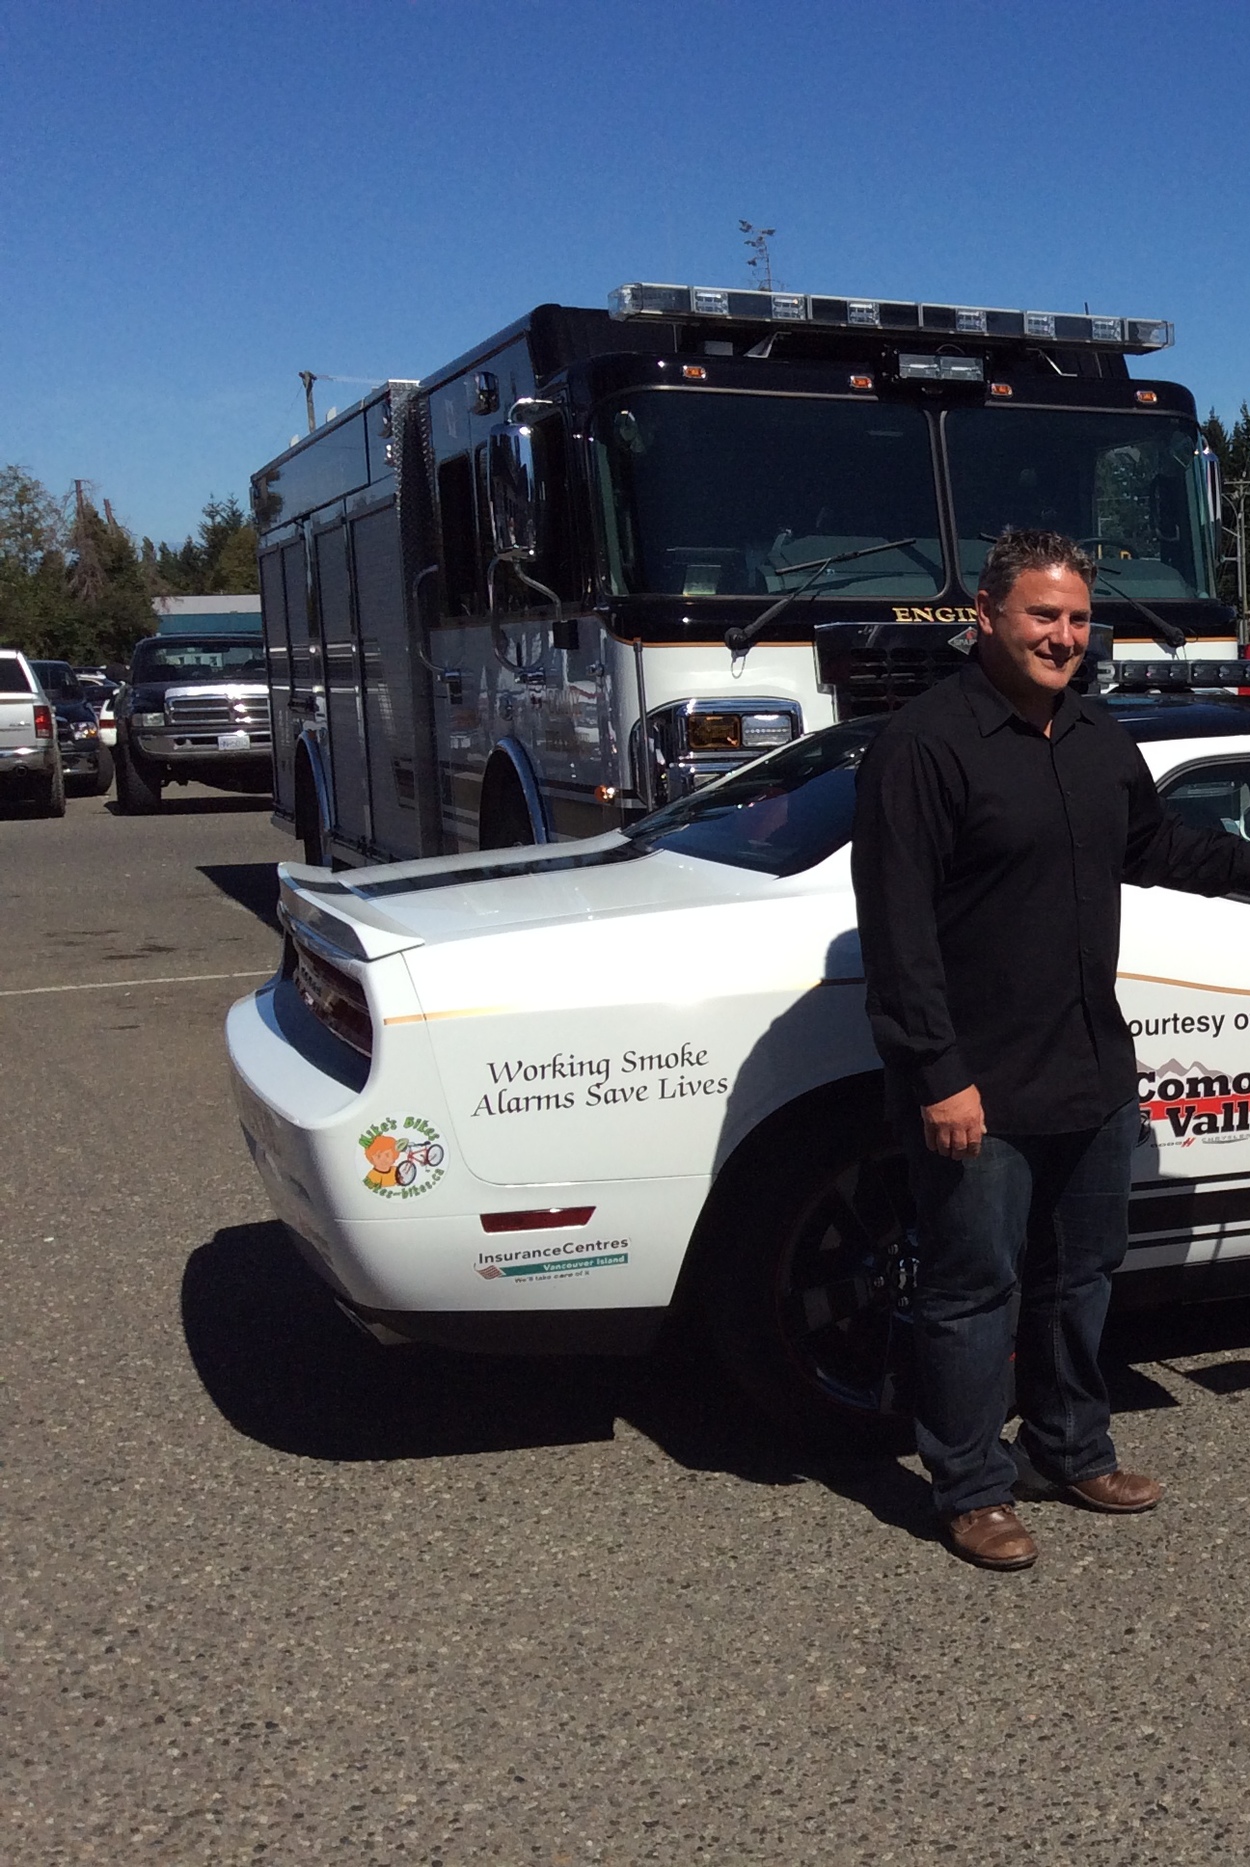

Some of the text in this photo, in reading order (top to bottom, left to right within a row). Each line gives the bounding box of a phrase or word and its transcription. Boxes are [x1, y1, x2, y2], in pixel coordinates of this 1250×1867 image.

[892, 607, 978, 622] ENGIN
[1130, 1013, 1225, 1038] ourtesy
[486, 1042, 709, 1085] Working Smoke
[470, 1075, 728, 1117] Alarms Save Lives
[358, 1116, 440, 1149] Mike's Bikes
[1201, 1133, 1250, 1142] CHRYSLER
[478, 1238, 629, 1264] InsuranceCentres
[543, 1255, 625, 1272] Vancouver Island
